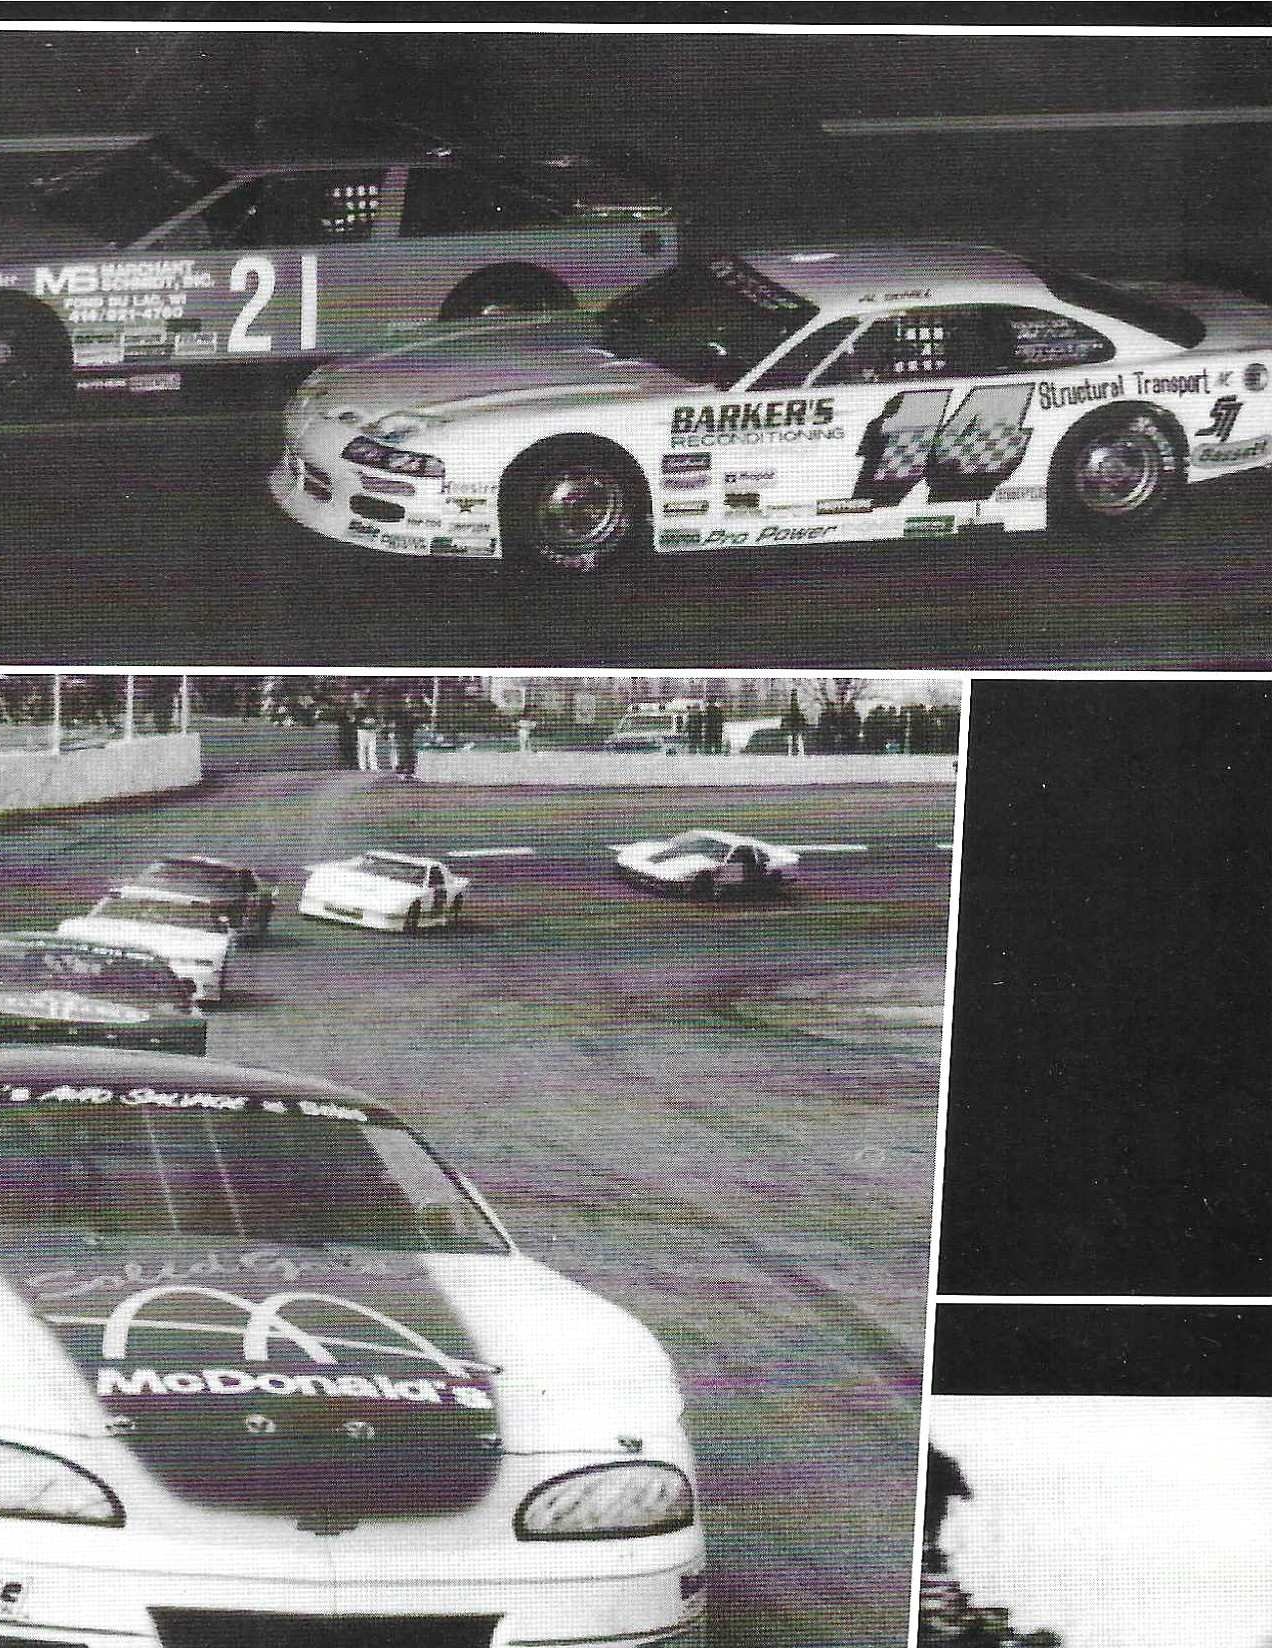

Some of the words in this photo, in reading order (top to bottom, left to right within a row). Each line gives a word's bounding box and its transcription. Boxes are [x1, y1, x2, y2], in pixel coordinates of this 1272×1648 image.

[101, 260, 196, 277] MARCHANT
[228, 254, 317, 352] 21
[1038, 374, 1125, 410] Structural
[1132, 369, 1212, 398] Transport
[670, 398, 836, 433] BARKER'S
[670, 427, 846, 449] RECONDITIONING
[702, 529, 750, 547] Pro
[755, 525, 839, 542] Power
[97, 1368, 494, 1410] McDonald's
